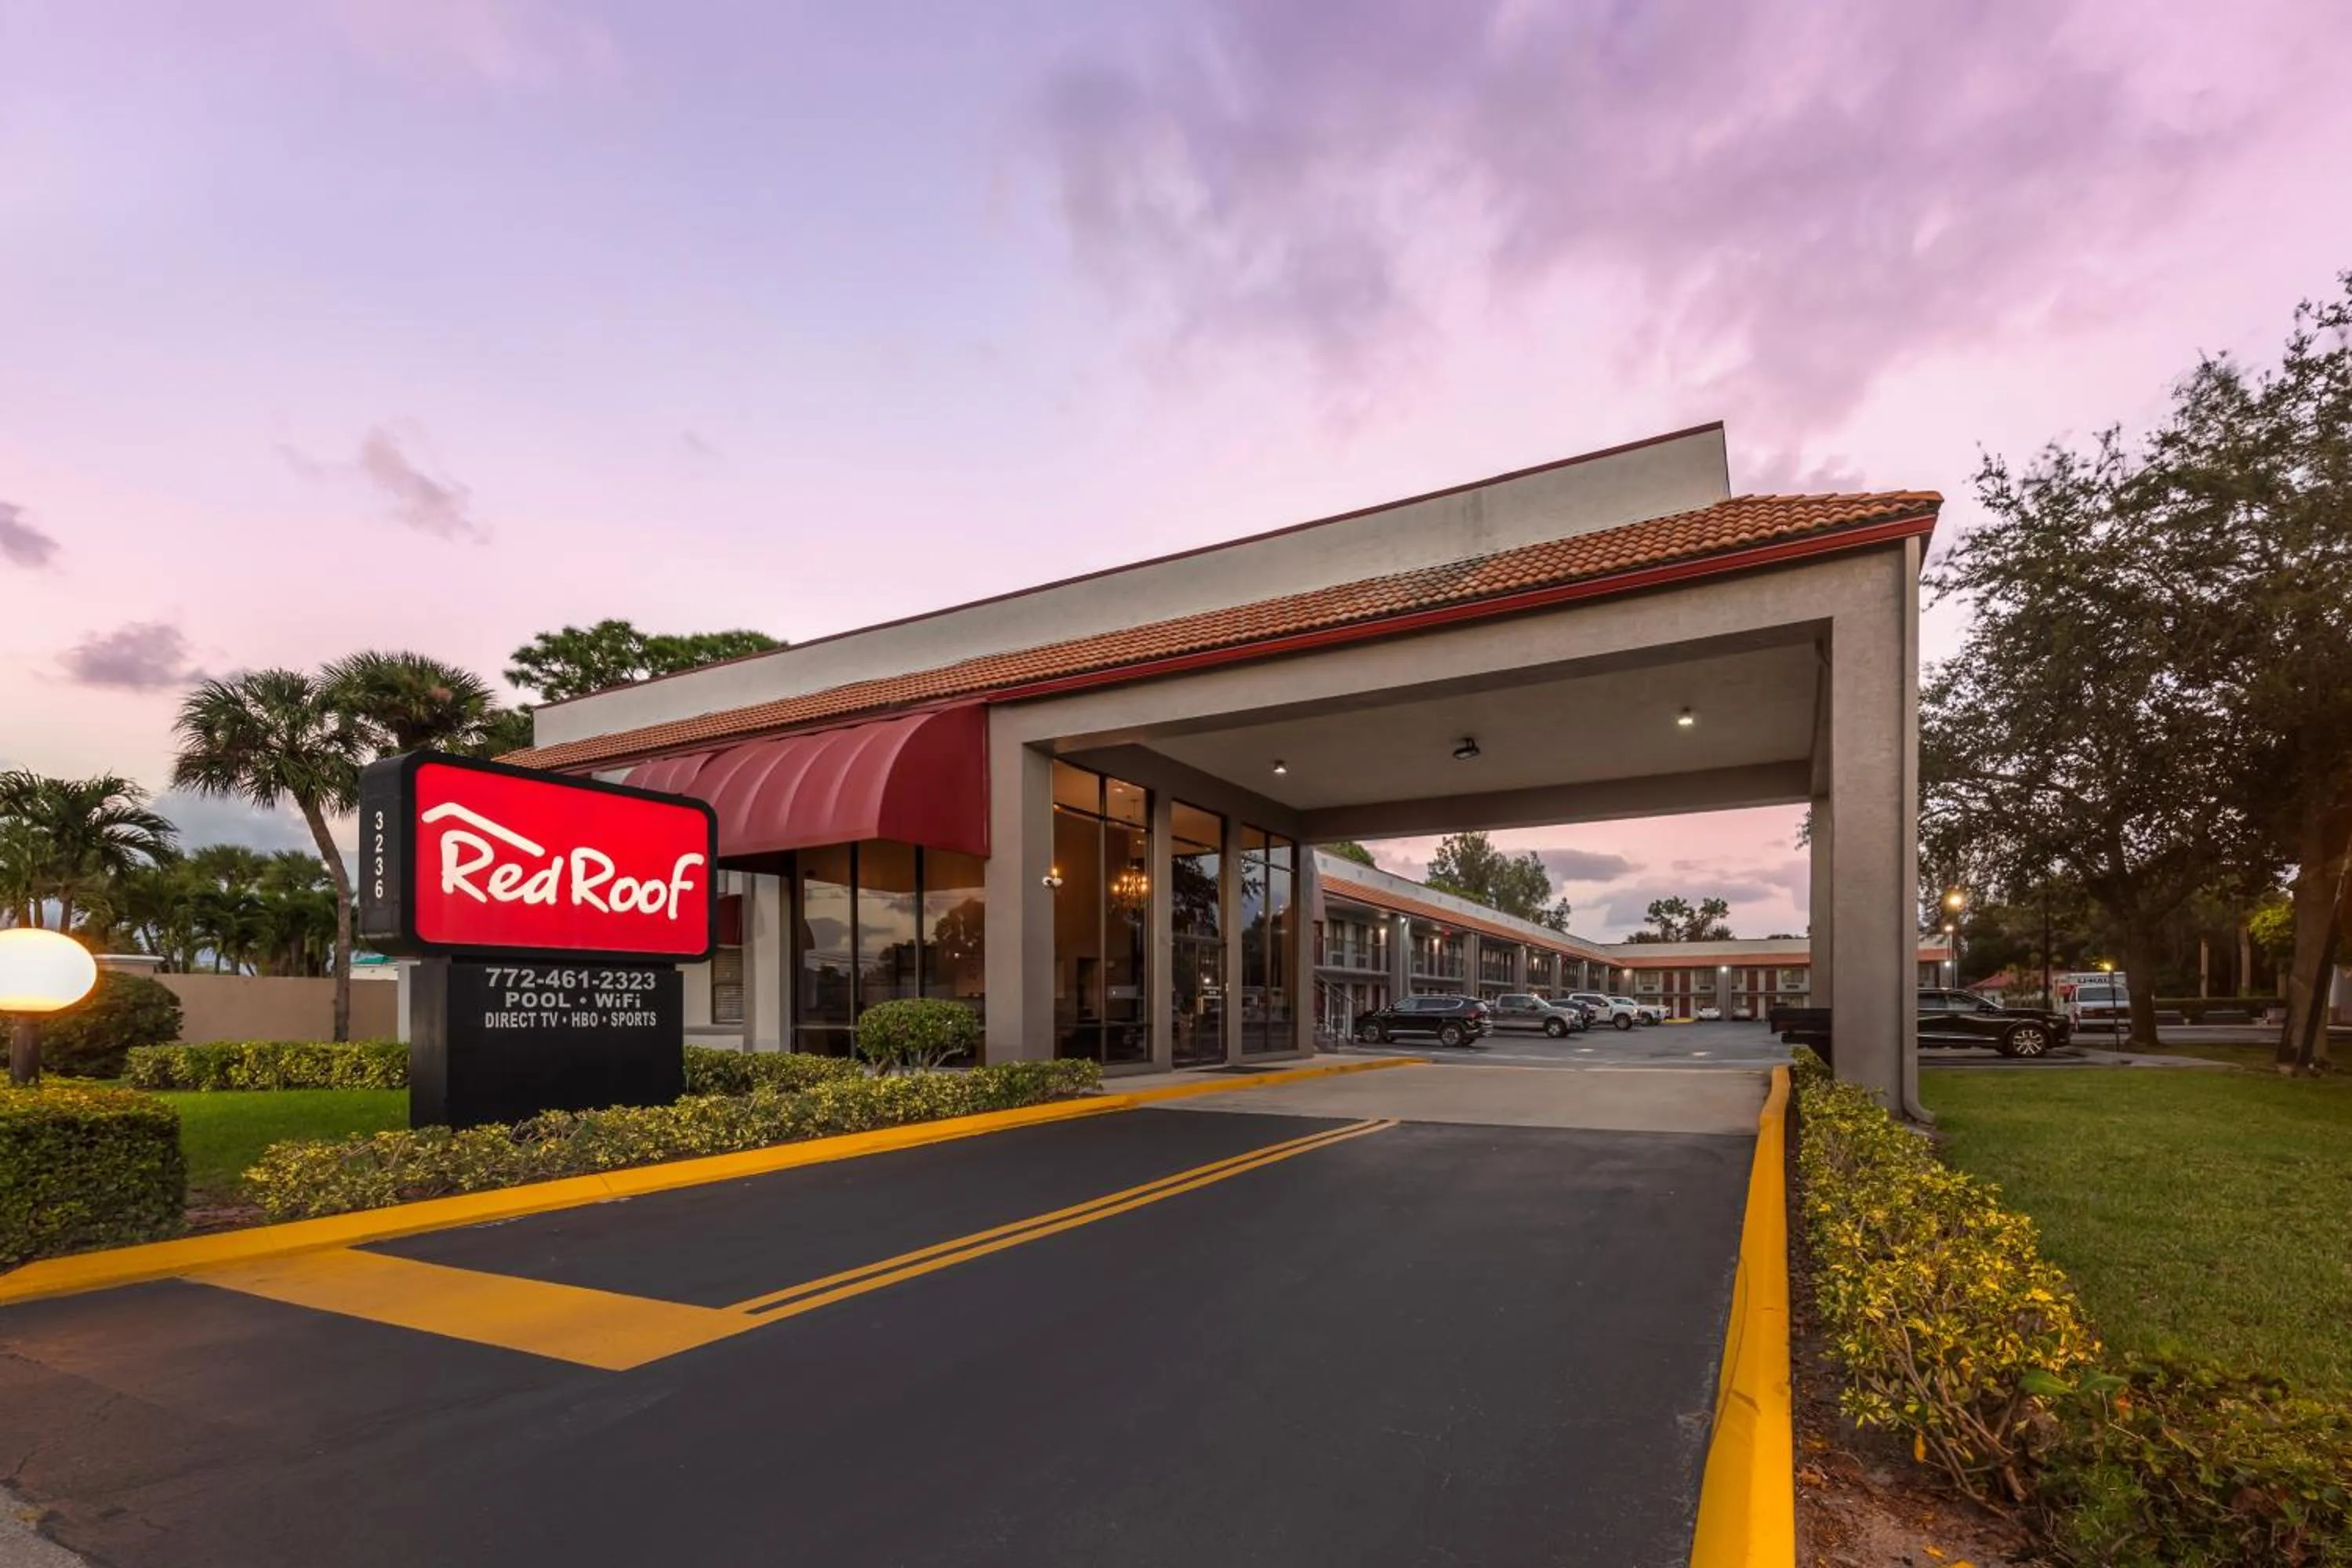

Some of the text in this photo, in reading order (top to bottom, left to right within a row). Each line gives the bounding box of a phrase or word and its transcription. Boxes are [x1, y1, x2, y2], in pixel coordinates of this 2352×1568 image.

[375, 811, 383, 898] 3236
[441, 830, 704, 920] Red Roof
[485, 967, 656, 989] 772-461-2323
[505, 992, 641, 1008] POOL WiFi
[485, 1011, 657, 1029] DIRECT TV HBO SPORTS
